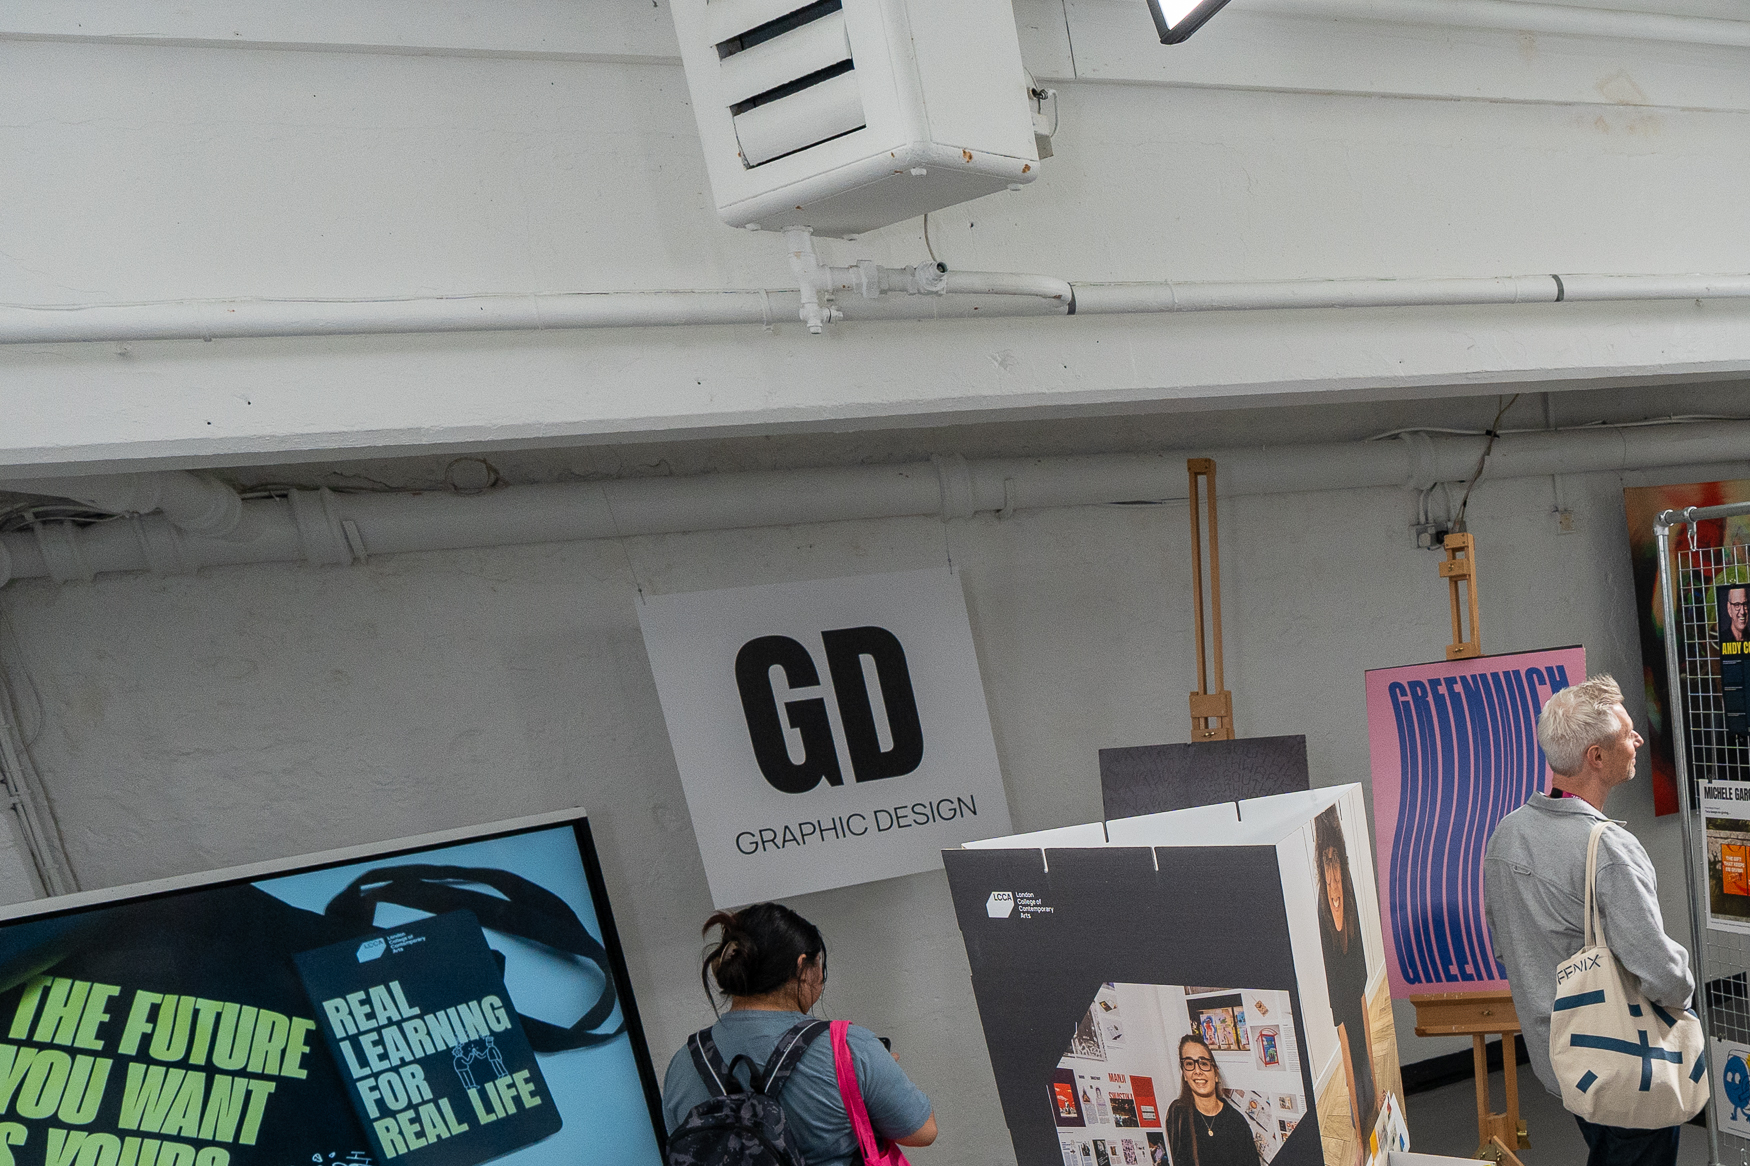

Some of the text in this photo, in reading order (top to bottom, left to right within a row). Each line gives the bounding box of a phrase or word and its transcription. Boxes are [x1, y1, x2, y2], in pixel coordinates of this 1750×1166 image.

[1722, 642, 1741, 655] ANDY
[734, 625, 924, 794] GD
[1704, 786, 1733, 801] MICHELE
[735, 795, 978, 856] GRAPHIC DESIGN
[993, 893, 1012, 901] LCCA
[1018, 905, 1054, 913] Contemporary
[1557, 954, 1601, 985] FENIX
[8, 975, 316, 1079] THE FUTURE
[322, 980, 420, 1039] REAL
[339, 995, 512, 1079] LEARNING
[0, 1043, 276, 1146] YOU WANT
[356, 1063, 433, 1119] FOR
[373, 1069, 542, 1159] REAL LIFE
